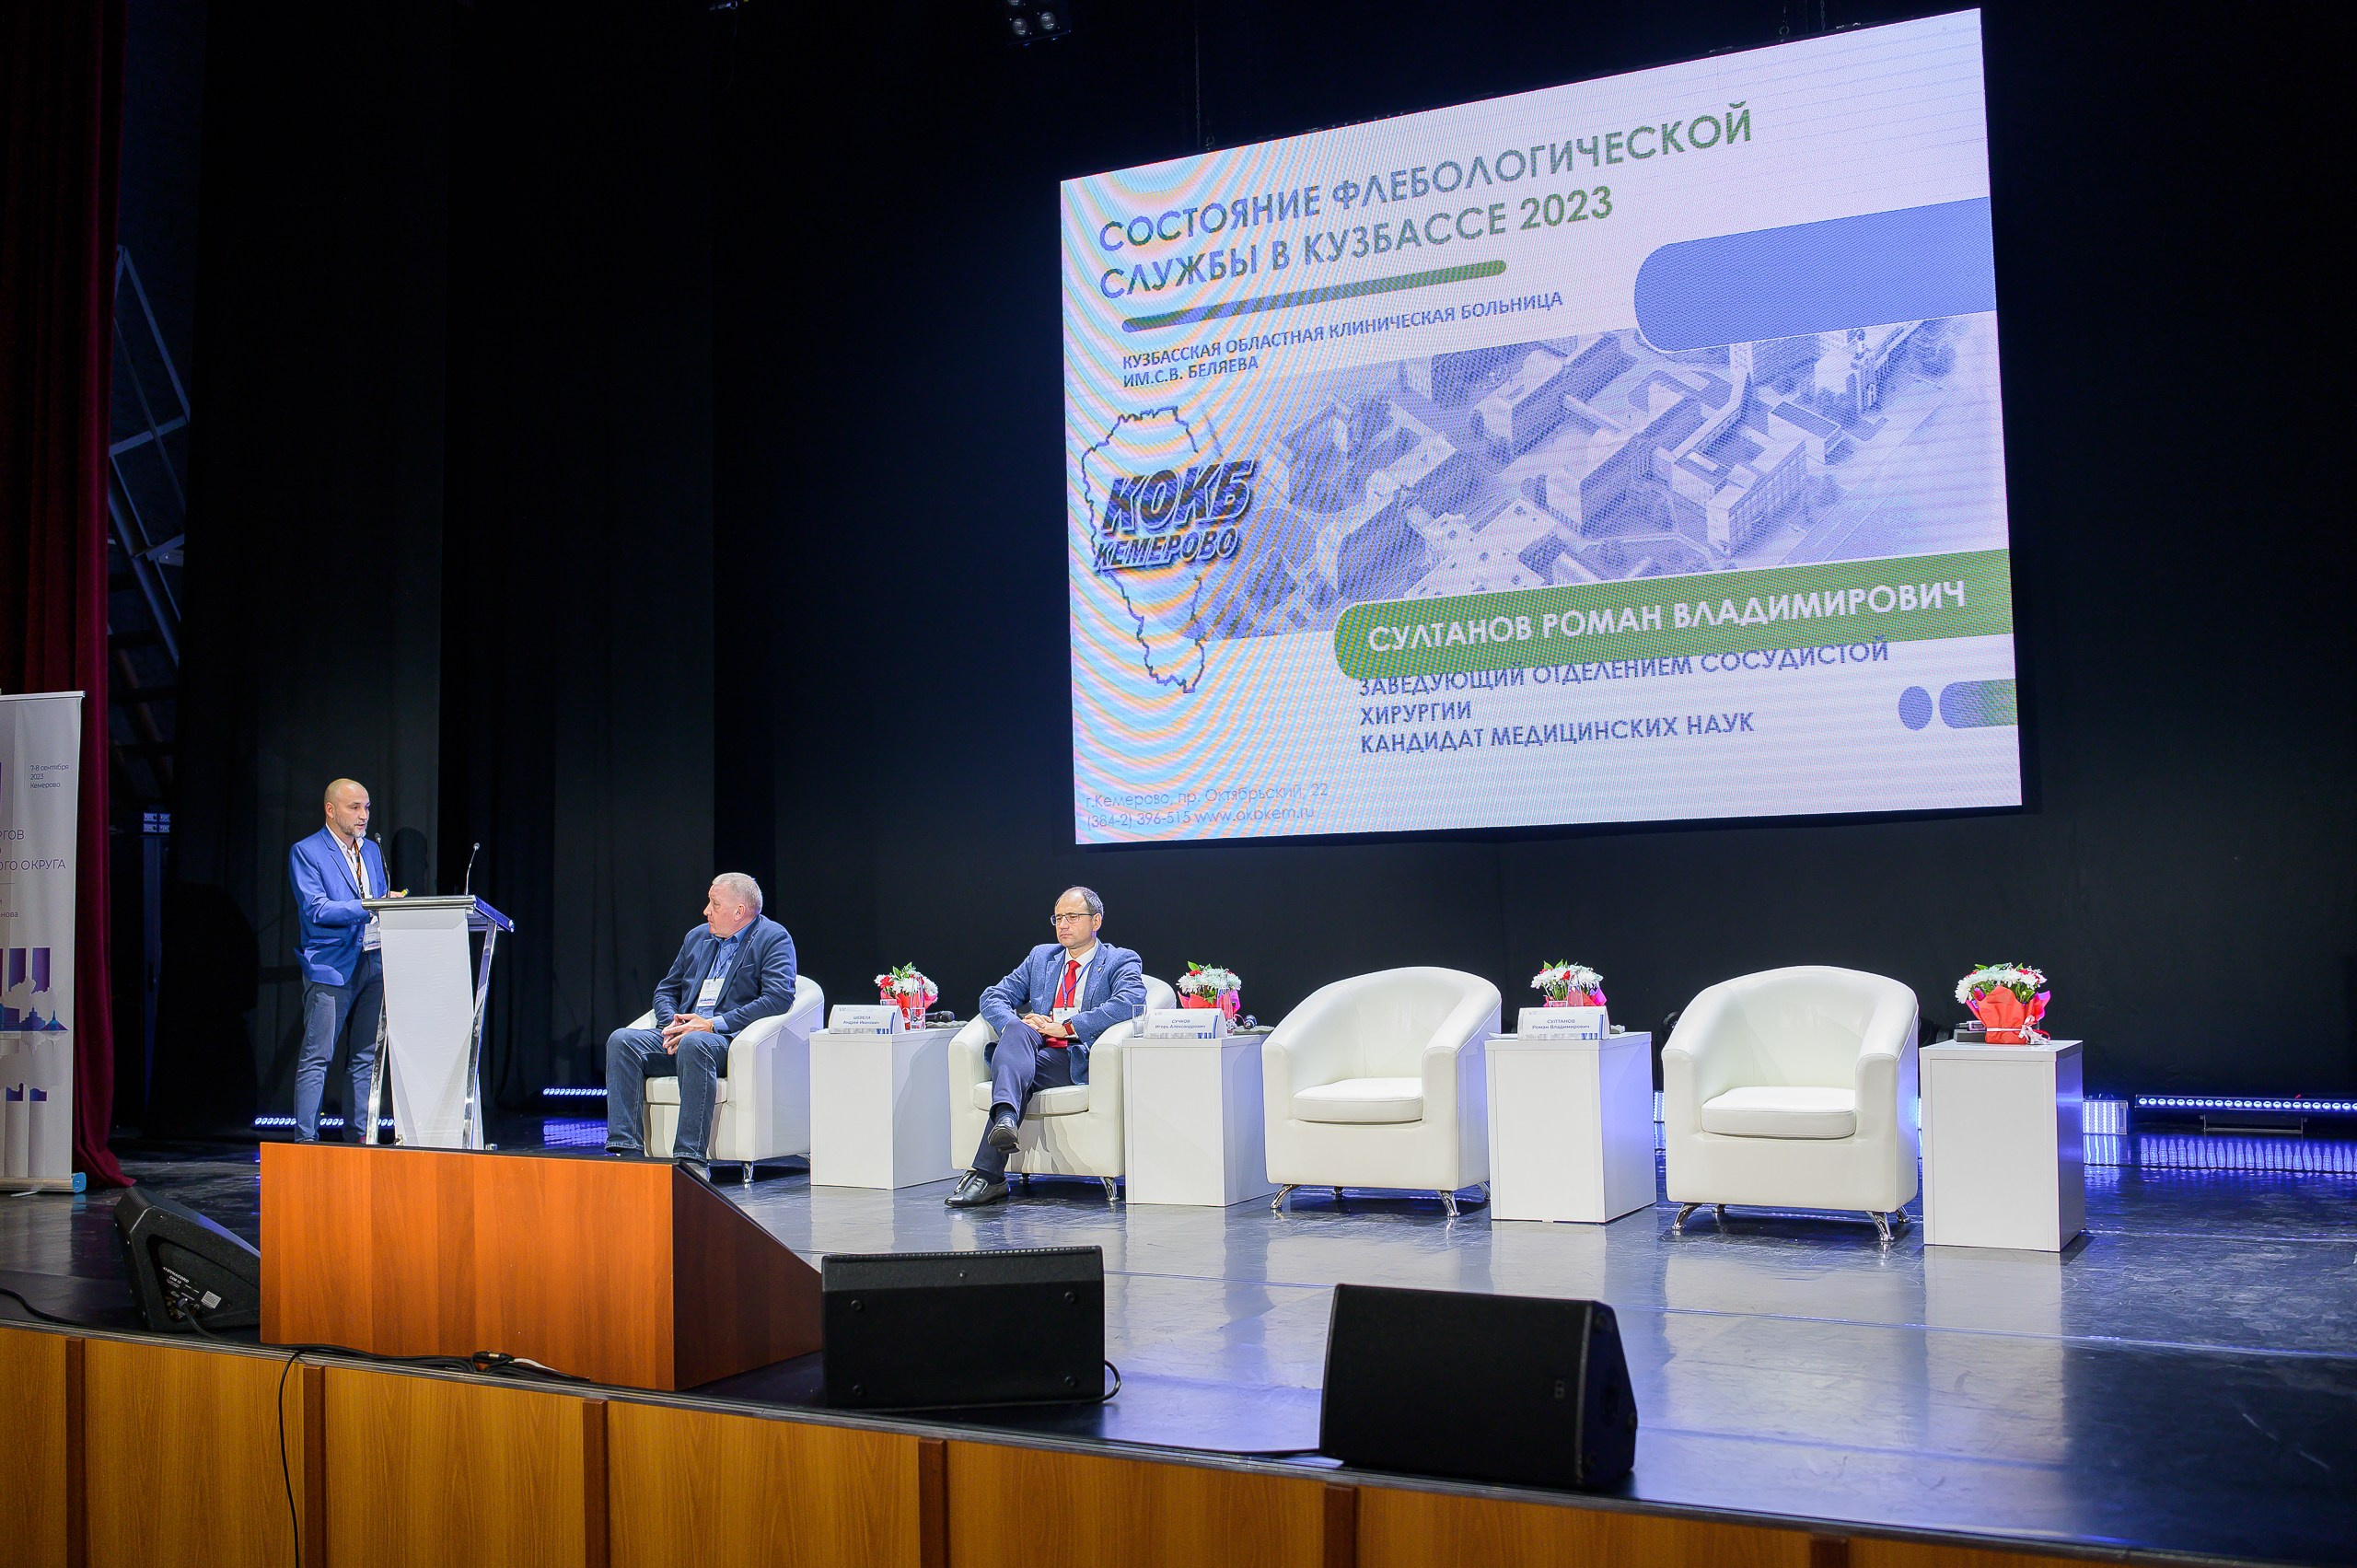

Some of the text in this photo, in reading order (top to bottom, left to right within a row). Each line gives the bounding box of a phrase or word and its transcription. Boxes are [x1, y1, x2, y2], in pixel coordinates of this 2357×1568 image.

[1100, 99, 1751, 251] СОСТОЯНИЕ ФЛЕБОЛОГИЧЕСКОЙ
[1100, 186, 1614, 299] СЛУЖБЫ В КУЗБАССЕ 2023
[1122, 291, 1563, 369] КУЗБАССКАЯ ОБЛАСТНАЯ КЛИНИЧЕСКАЯ БОЛЬНИЦА
[1123, 356, 1259, 388] ИМ.С.В. БЕЛЯЕВА
[1104, 459, 1256, 536] КОКБ
[1093, 527, 1239, 573] КЕМЕРОВО
[1368, 580, 1966, 652] СУЛТАНОВ РОМАН ВЛАДИМИРОВИЧ
[1360, 635, 1889, 697] ЗАВЕДУЮЩИЙ ОТДЕЛЕНИЕМ СОСУДИСТОЙ
[1360, 701, 1472, 727] ХИРУРГИИ
[1361, 712, 1755, 754] КАНДИДАТ МЕДИЦИНСКИХ НАУК
[1178, 793, 1201, 806] пр.
[1312, 783, 1328, 796] 22
[1137, 810, 1190, 826] 396-515
[20, 859, 66, 871] ОКРУГА
